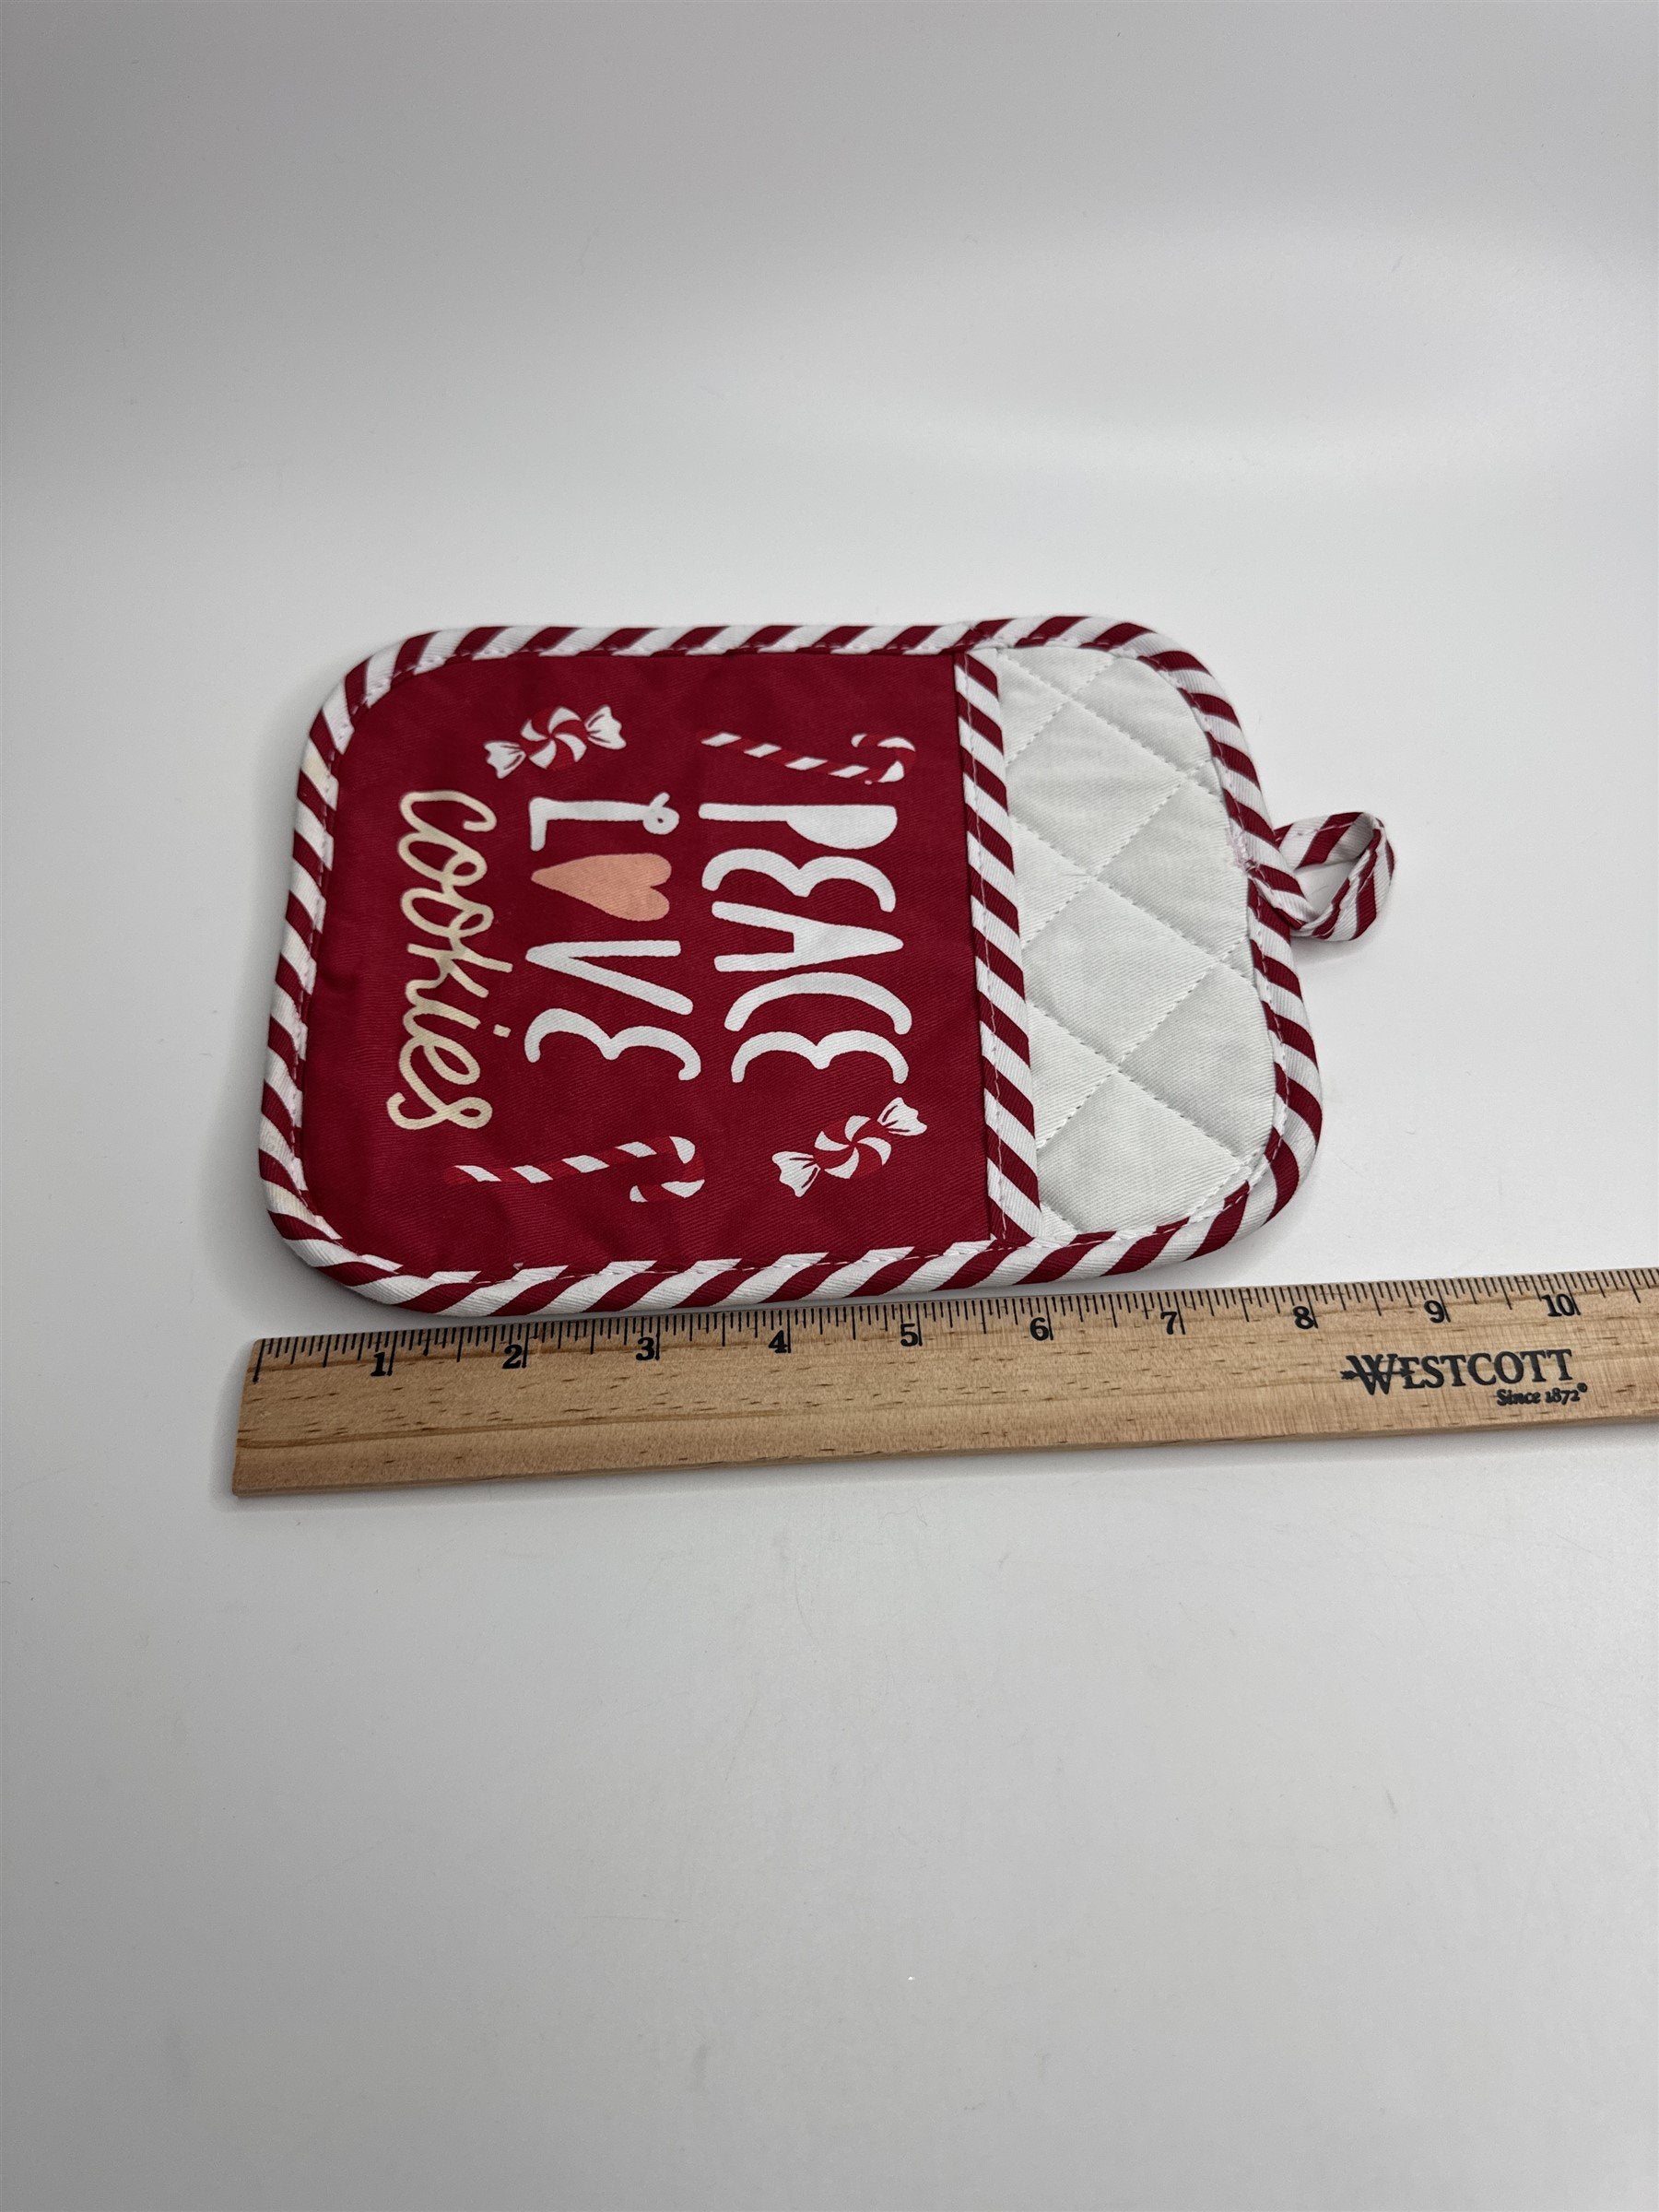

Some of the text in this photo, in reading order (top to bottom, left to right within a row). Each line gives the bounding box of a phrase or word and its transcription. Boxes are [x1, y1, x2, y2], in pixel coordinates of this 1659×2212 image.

[385, 789, 513, 1130] cookies
[699, 803, 912, 1083] PEACE
[370, 1293, 1576, 1377] 1 2 3 4 5 6 7 8 9 10
[1340, 1348, 1573, 1395] WESTCOTT
[1496, 1388, 1541, 1406] Since
